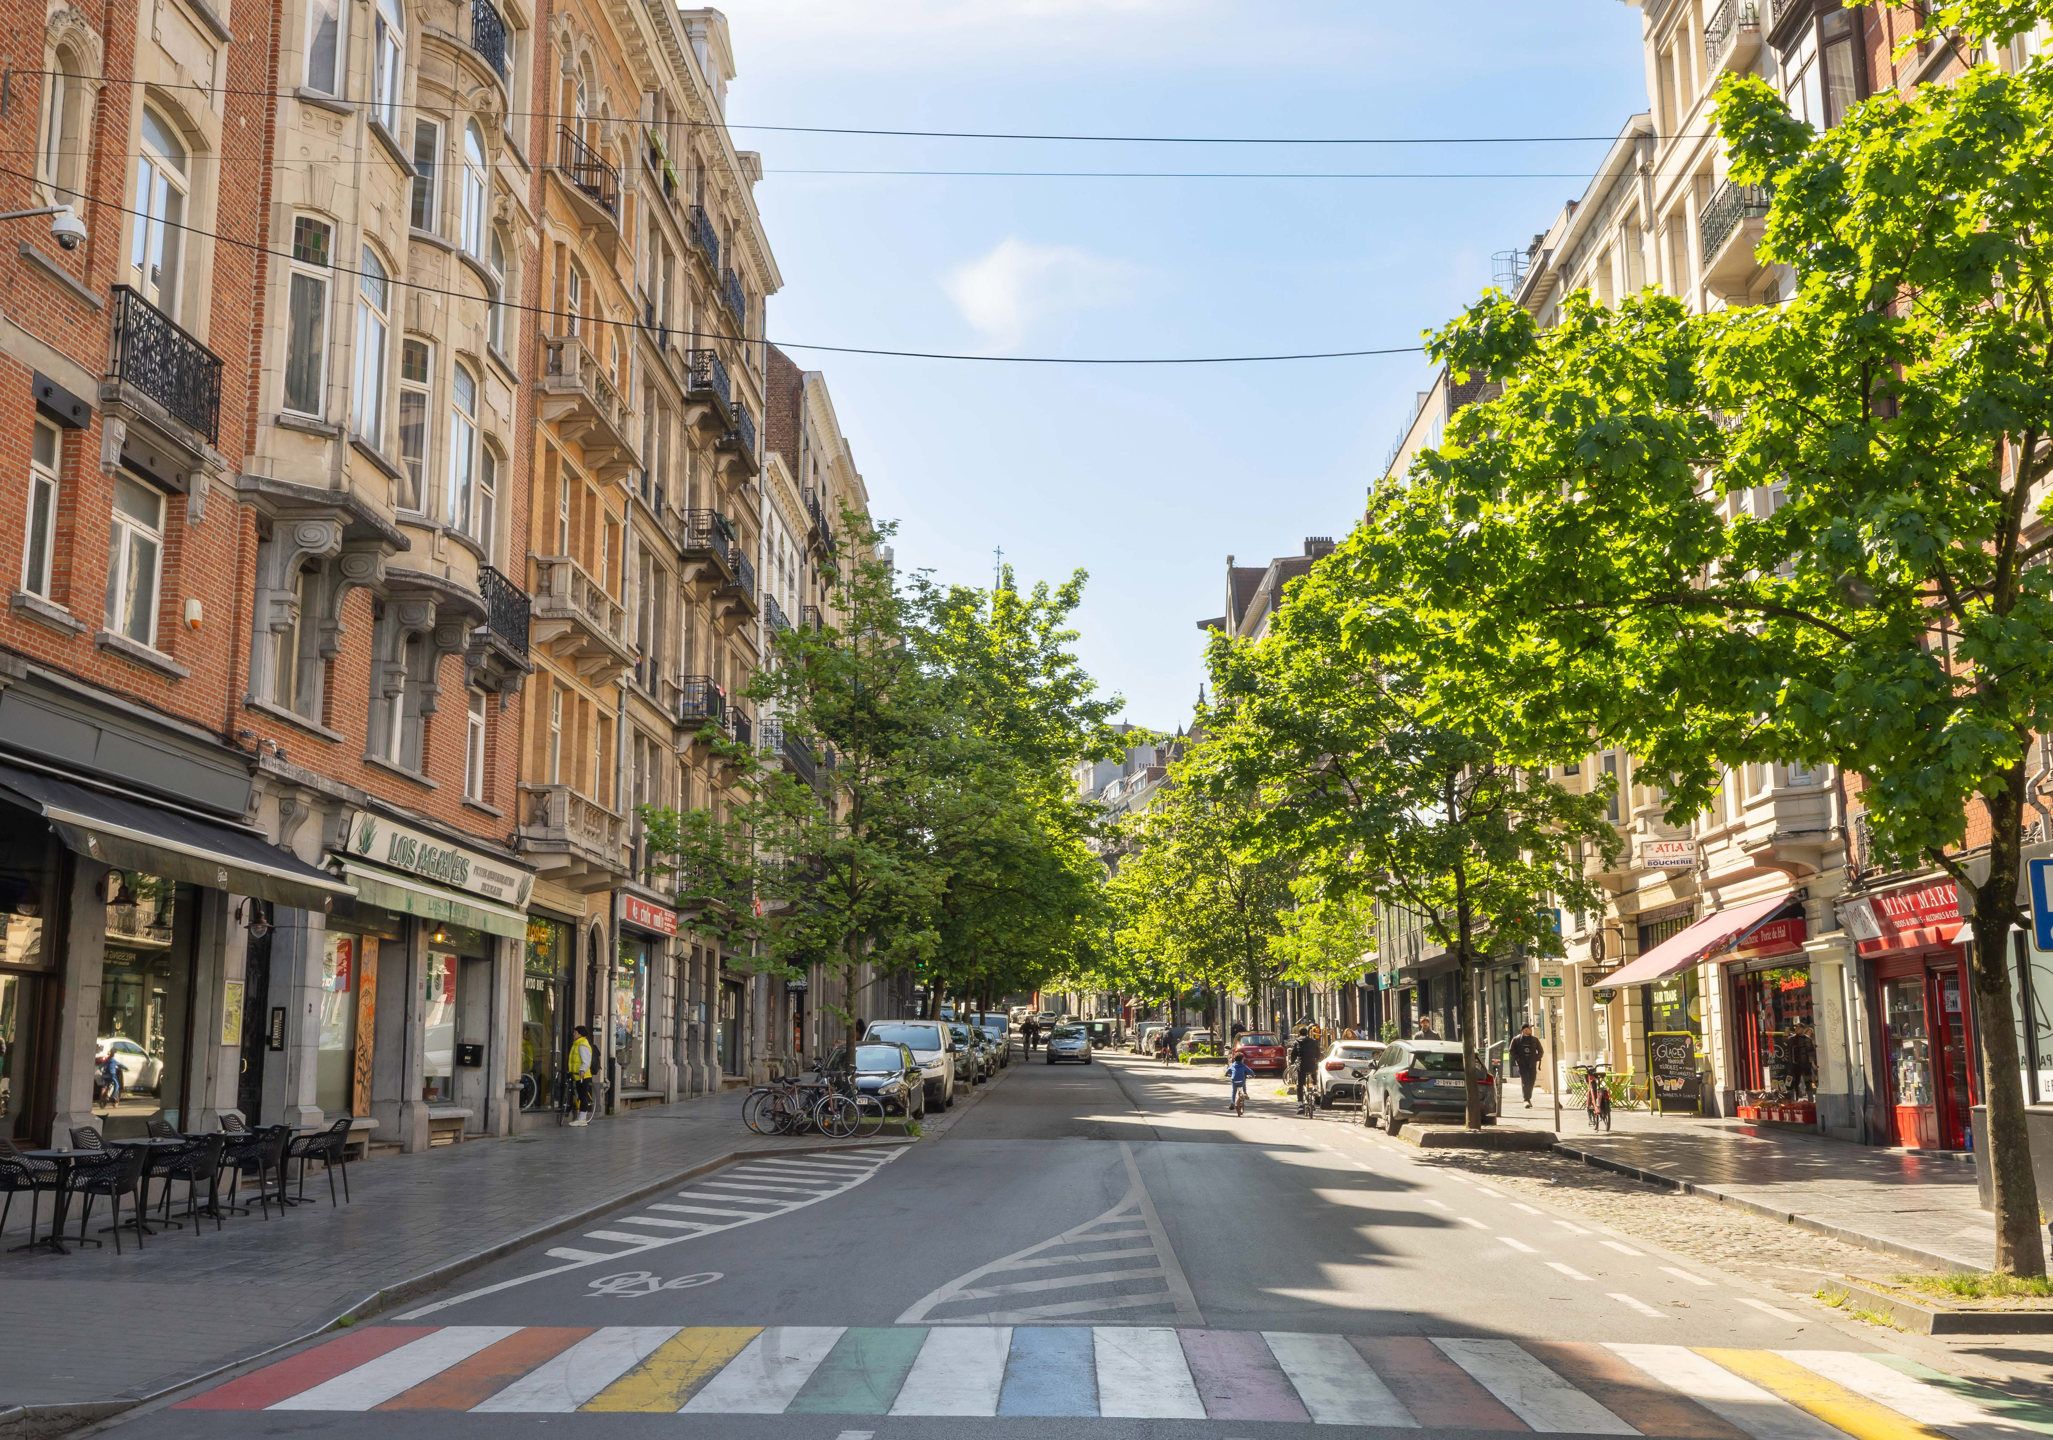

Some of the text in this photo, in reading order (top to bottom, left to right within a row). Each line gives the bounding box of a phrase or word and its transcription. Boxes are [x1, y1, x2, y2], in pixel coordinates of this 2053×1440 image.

[1655, 842, 1684, 853] ATIA
[388, 832, 417, 866] LOS
[417, 843, 470, 884] AGAVES
[1881, 884, 1958, 916] MINI MARK
[1761, 930, 1772, 941] Porte
[1772, 929, 1777, 939] de
[1777, 925, 1786, 938] Hal
[1654, 990, 1677, 1003] FAIR TRADE
